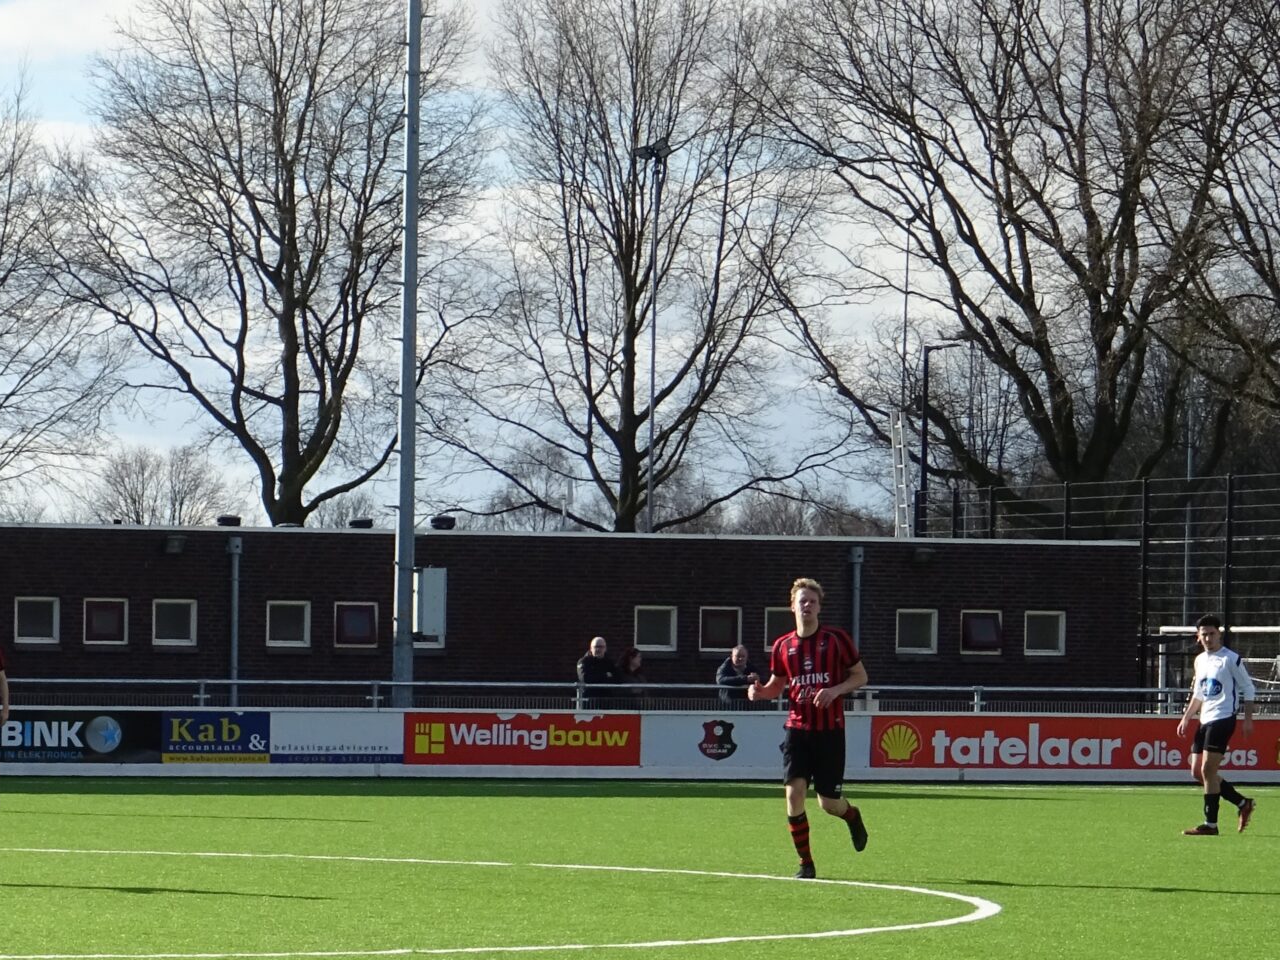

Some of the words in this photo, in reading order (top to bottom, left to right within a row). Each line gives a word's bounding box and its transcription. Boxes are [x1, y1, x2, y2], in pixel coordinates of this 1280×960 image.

[169, 717, 241, 742] Kab
[449, 723, 629, 750] Wellingbouw
[248, 733, 267, 751] &
[274, 744, 389, 752] belastingadviseurs
[932, 723, 1121, 766] tatelaar
[1132, 740, 1181, 766] Olie
[17, 751, 84, 759] ELEKTRONICA
